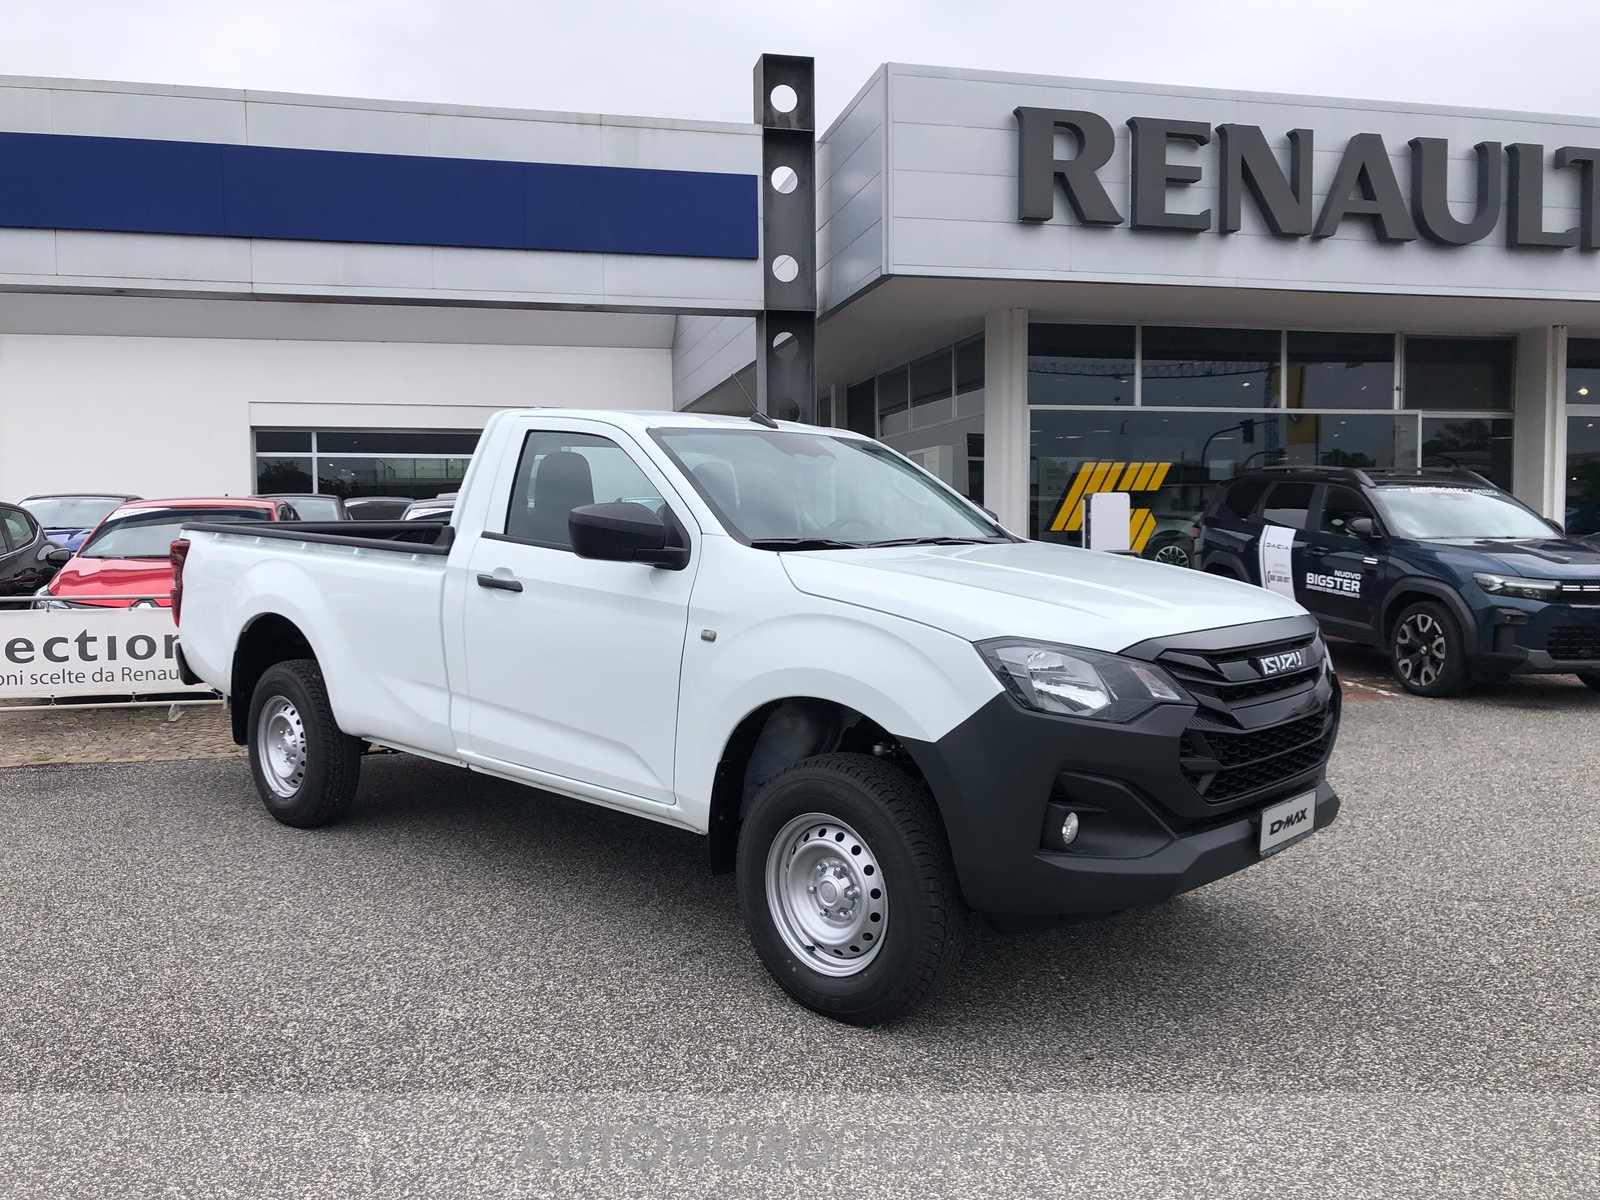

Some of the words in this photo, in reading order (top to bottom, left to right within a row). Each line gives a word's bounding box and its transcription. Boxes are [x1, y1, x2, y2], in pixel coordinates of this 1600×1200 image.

[1013, 106, 1600, 251] RENAULT
[1266, 542, 1289, 551] DACIA
[1306, 572, 1361, 592] BIGSTER
[1334, 569, 1361, 580] NUOVO
[1260, 651, 1302, 675] ISUZU
[30, 668, 86, 685] scelte
[91, 667, 115, 682] da
